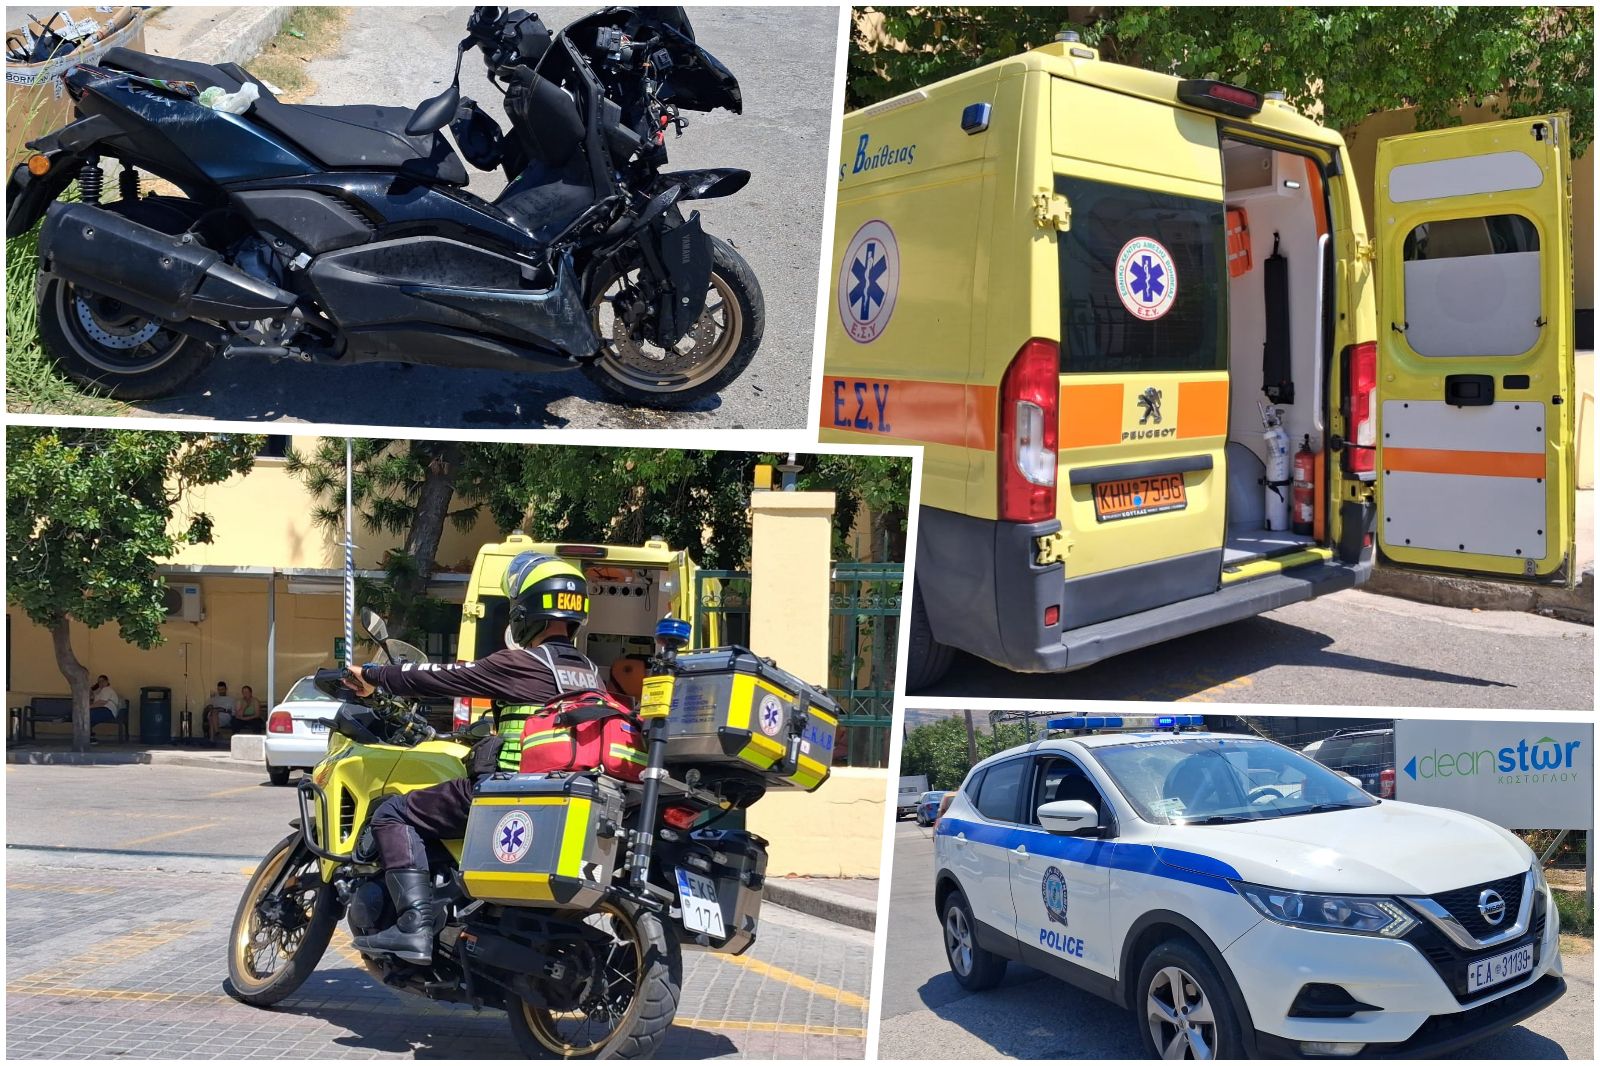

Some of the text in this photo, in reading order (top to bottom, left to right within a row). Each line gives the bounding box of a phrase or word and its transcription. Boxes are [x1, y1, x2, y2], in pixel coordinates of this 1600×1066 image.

[852, 133, 916, 174] Βοήθειας
[1121, 428, 1177, 440] PEUGEOT
[695, 906, 722, 933] 171
[1040, 928, 1084, 958] POLICE
[1502, 949, 1528, 977] 31139
